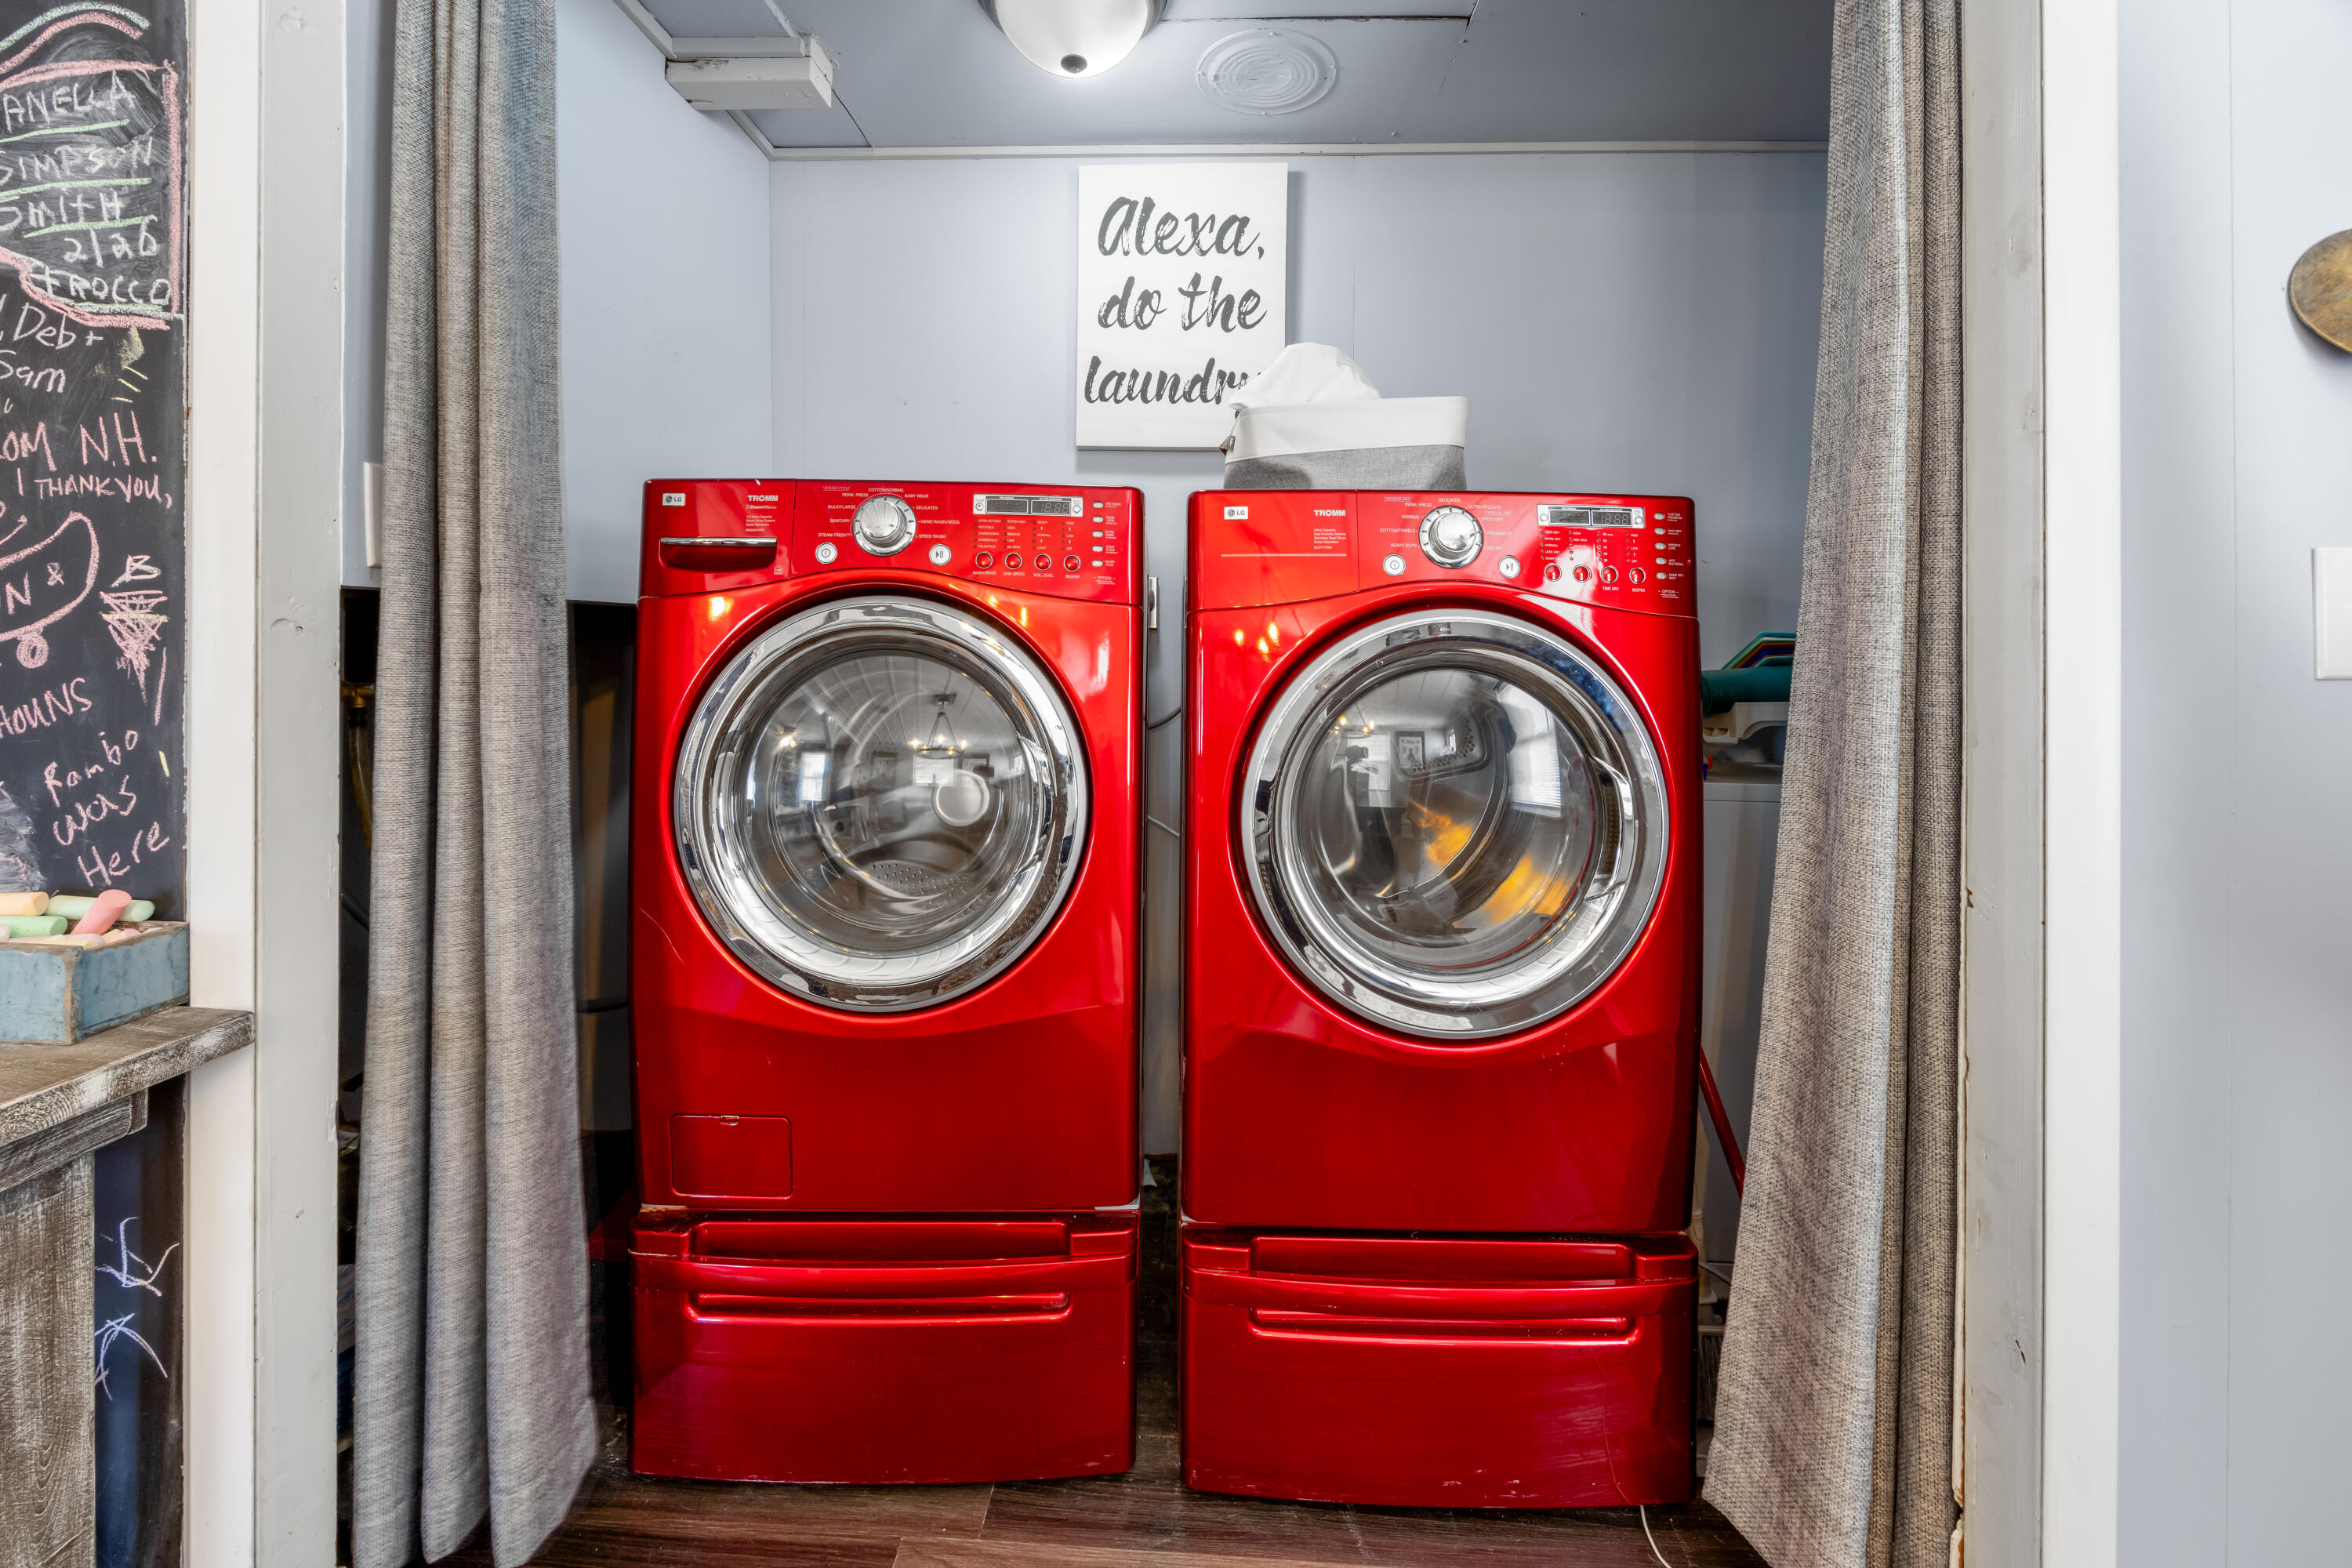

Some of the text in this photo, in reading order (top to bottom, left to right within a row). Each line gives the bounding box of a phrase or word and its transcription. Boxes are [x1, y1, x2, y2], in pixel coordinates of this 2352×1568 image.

[1098, 196, 1265, 260] Alexa,
[13, 302, 77, 350] Deb
[1098, 272, 1268, 333] do the
[0, 350, 66, 393] Sam
[0, 420, 57, 471] OM
[34, 474, 115, 500] THANK
[78, 822, 169, 887] Here
